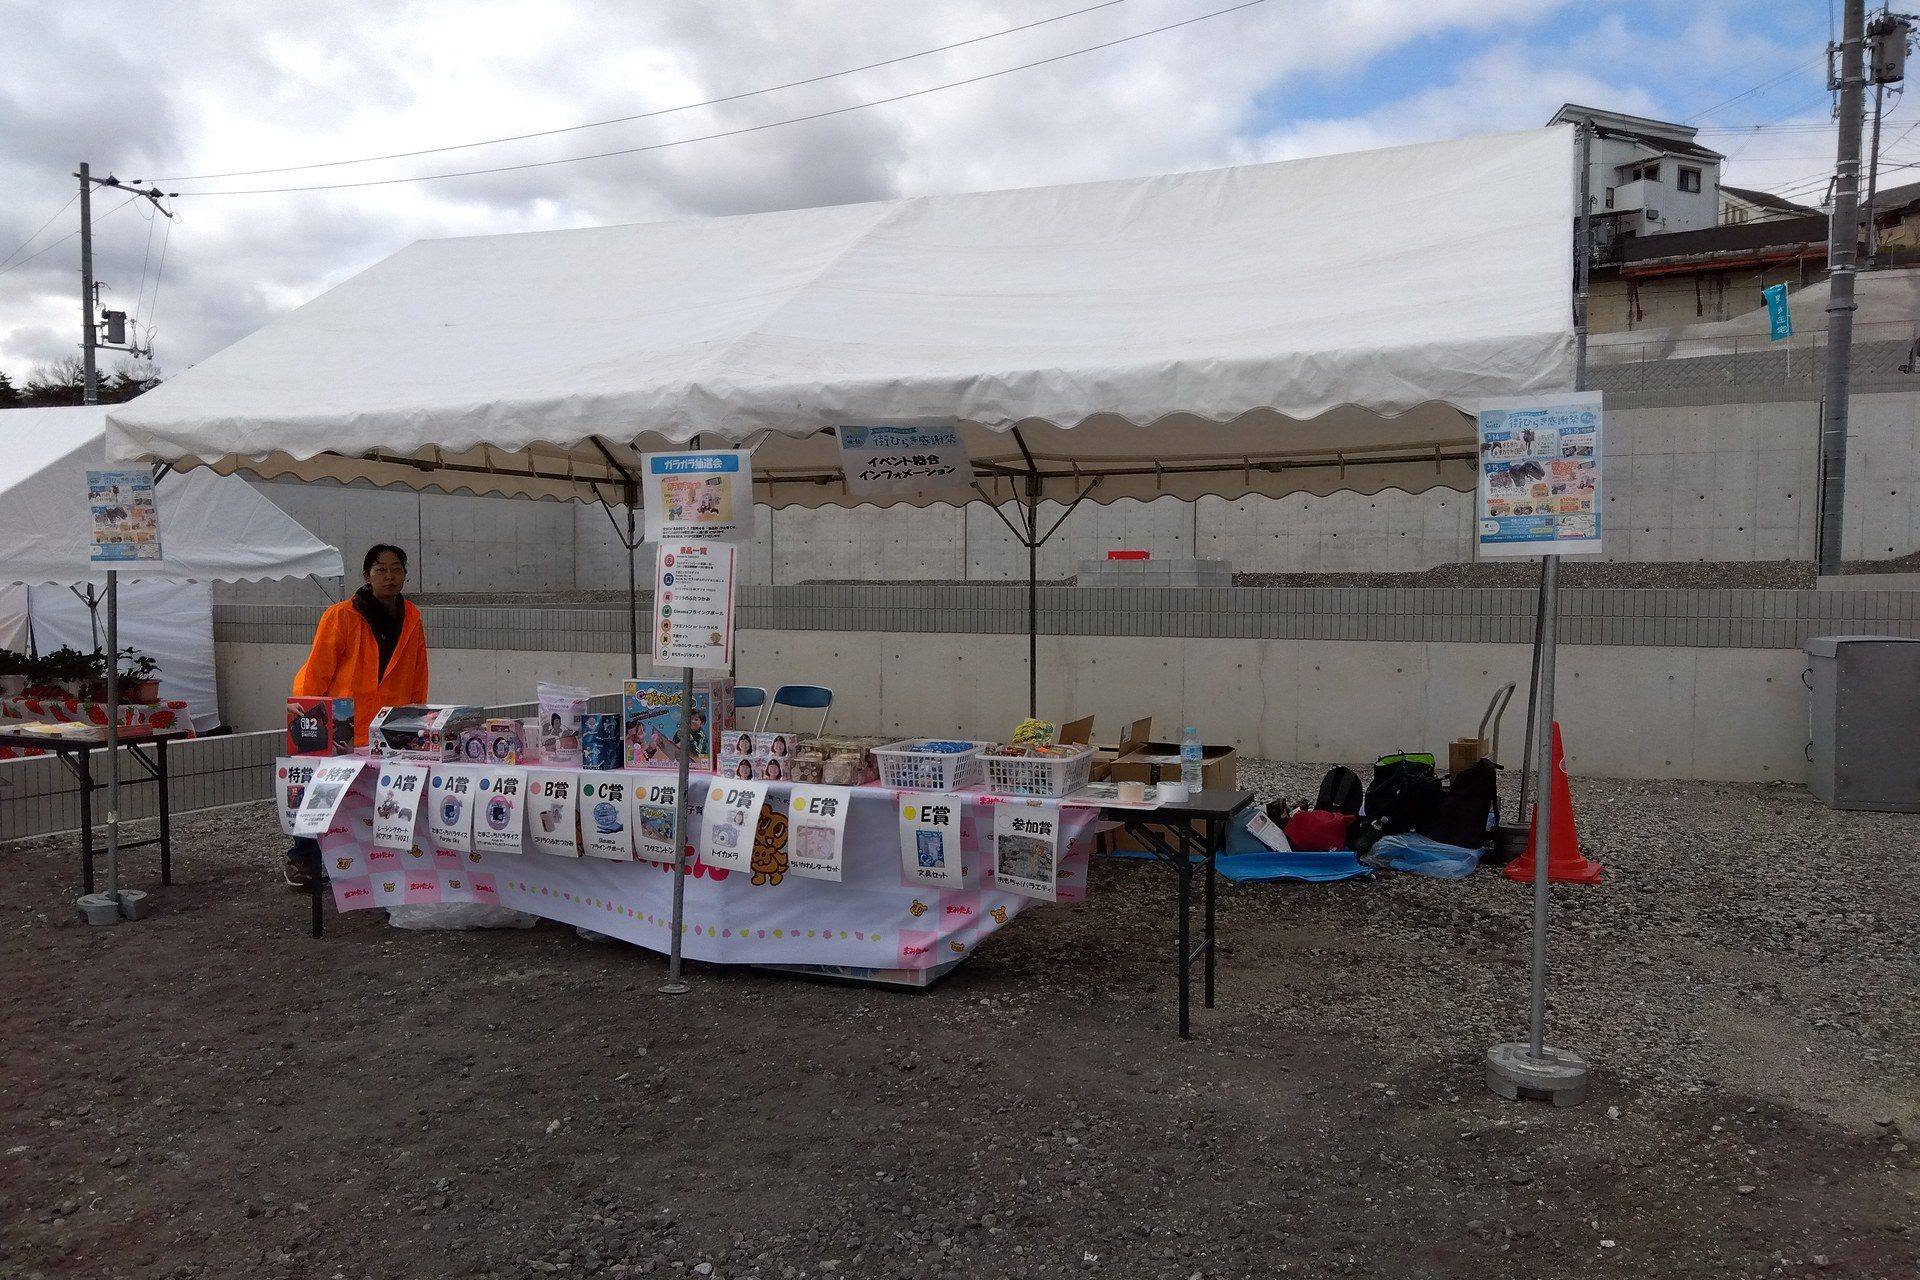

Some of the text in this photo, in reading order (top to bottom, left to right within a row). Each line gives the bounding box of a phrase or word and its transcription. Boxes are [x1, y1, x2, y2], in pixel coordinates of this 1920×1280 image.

[664, 458, 723, 469] ガラガラ抽選会
[868, 454, 940, 467] イベント総合
[859, 465, 957, 480] インフォメーション
[392, 775, 418, 792] A賞
[444, 776, 470, 794] A賞
[492, 777, 519, 795] A賞
[544, 781, 569, 799] B賞
[598, 783, 624, 802] C賞
[650, 786, 676, 804] D賞
[726, 789, 756, 809] D賞
[809, 797, 839, 817] E賞
[920, 805, 951, 825] E賞
[1012, 817, 1053, 835] 参加賞
[711, 848, 739, 860] トイカメラ
[918, 869, 949, 879] 文具セット
